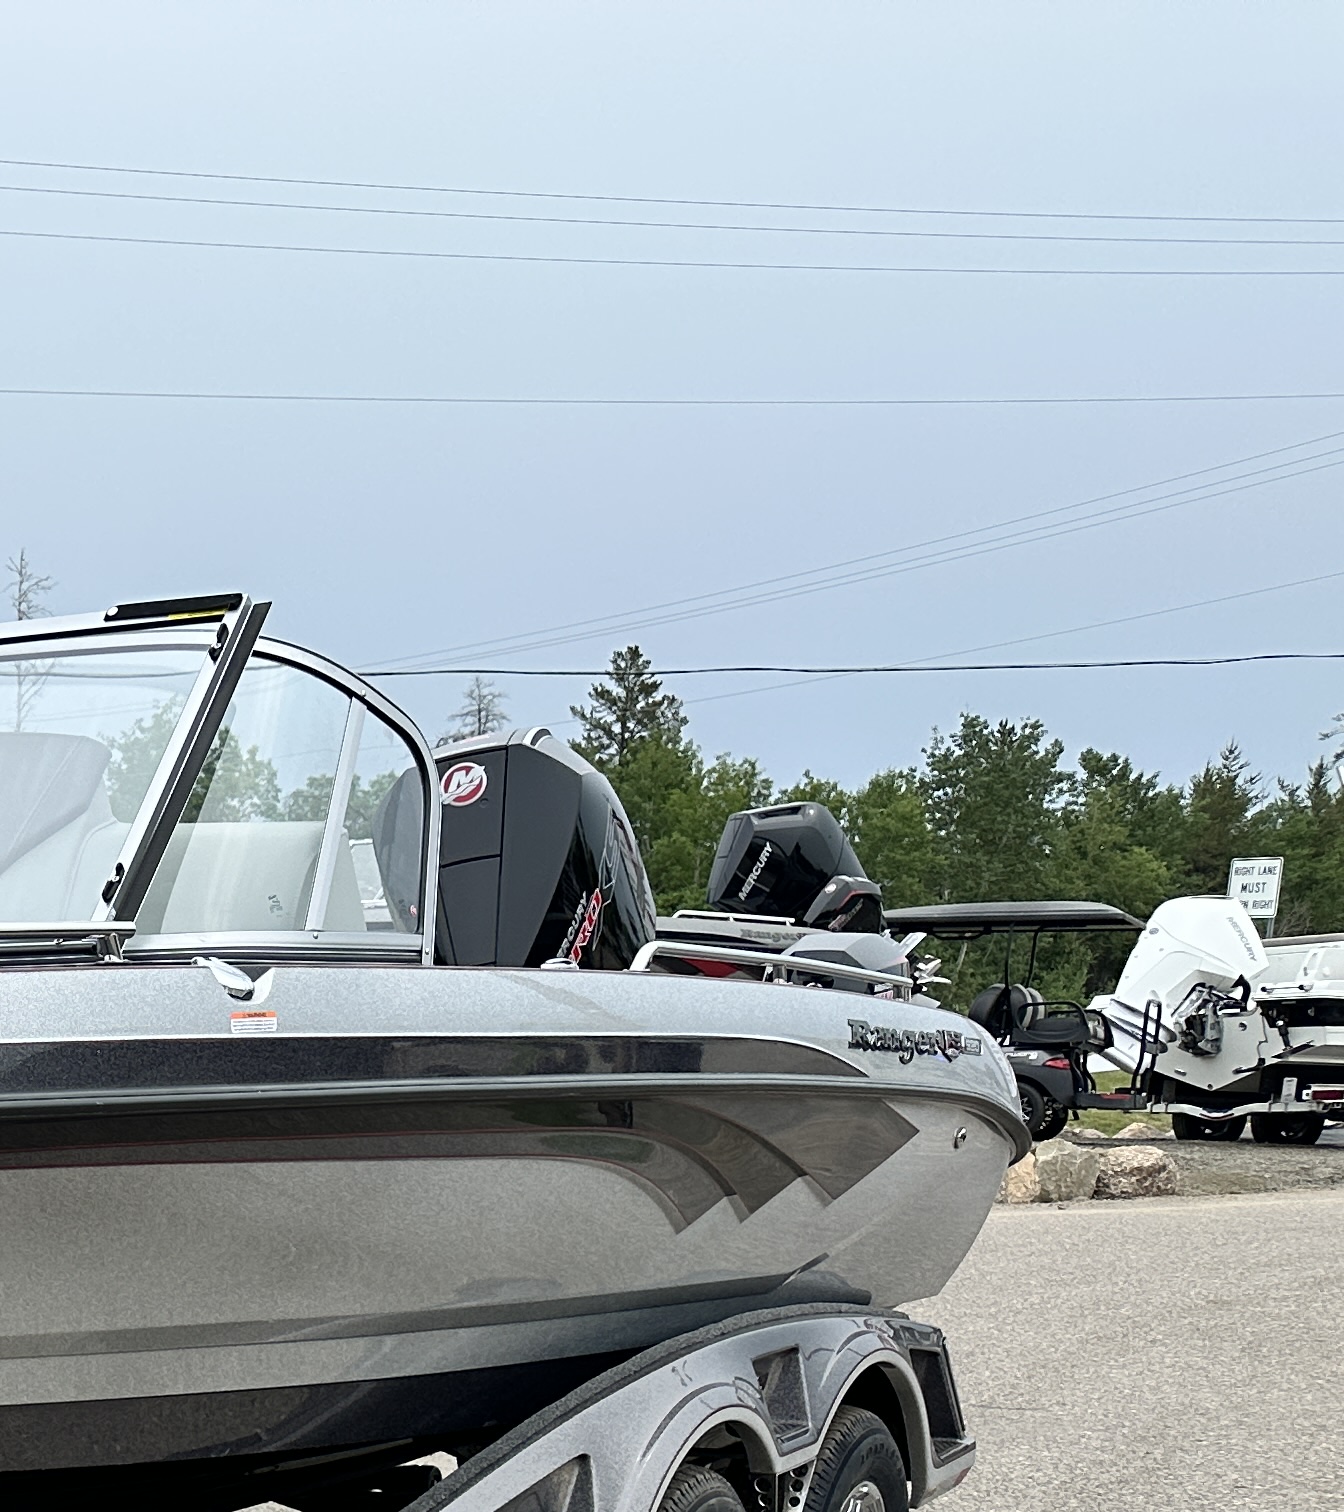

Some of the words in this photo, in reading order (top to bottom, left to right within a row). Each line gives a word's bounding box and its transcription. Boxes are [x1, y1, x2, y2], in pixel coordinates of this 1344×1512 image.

[738, 841, 773, 901] MERCURY
[1240, 881, 1267, 894] MUST
[1258, 866, 1278, 876] LANE
[556, 890, 587, 958] ERCURY
[1226, 916, 1257, 962] MERCURY
[847, 1018, 944, 1064] Ranger
